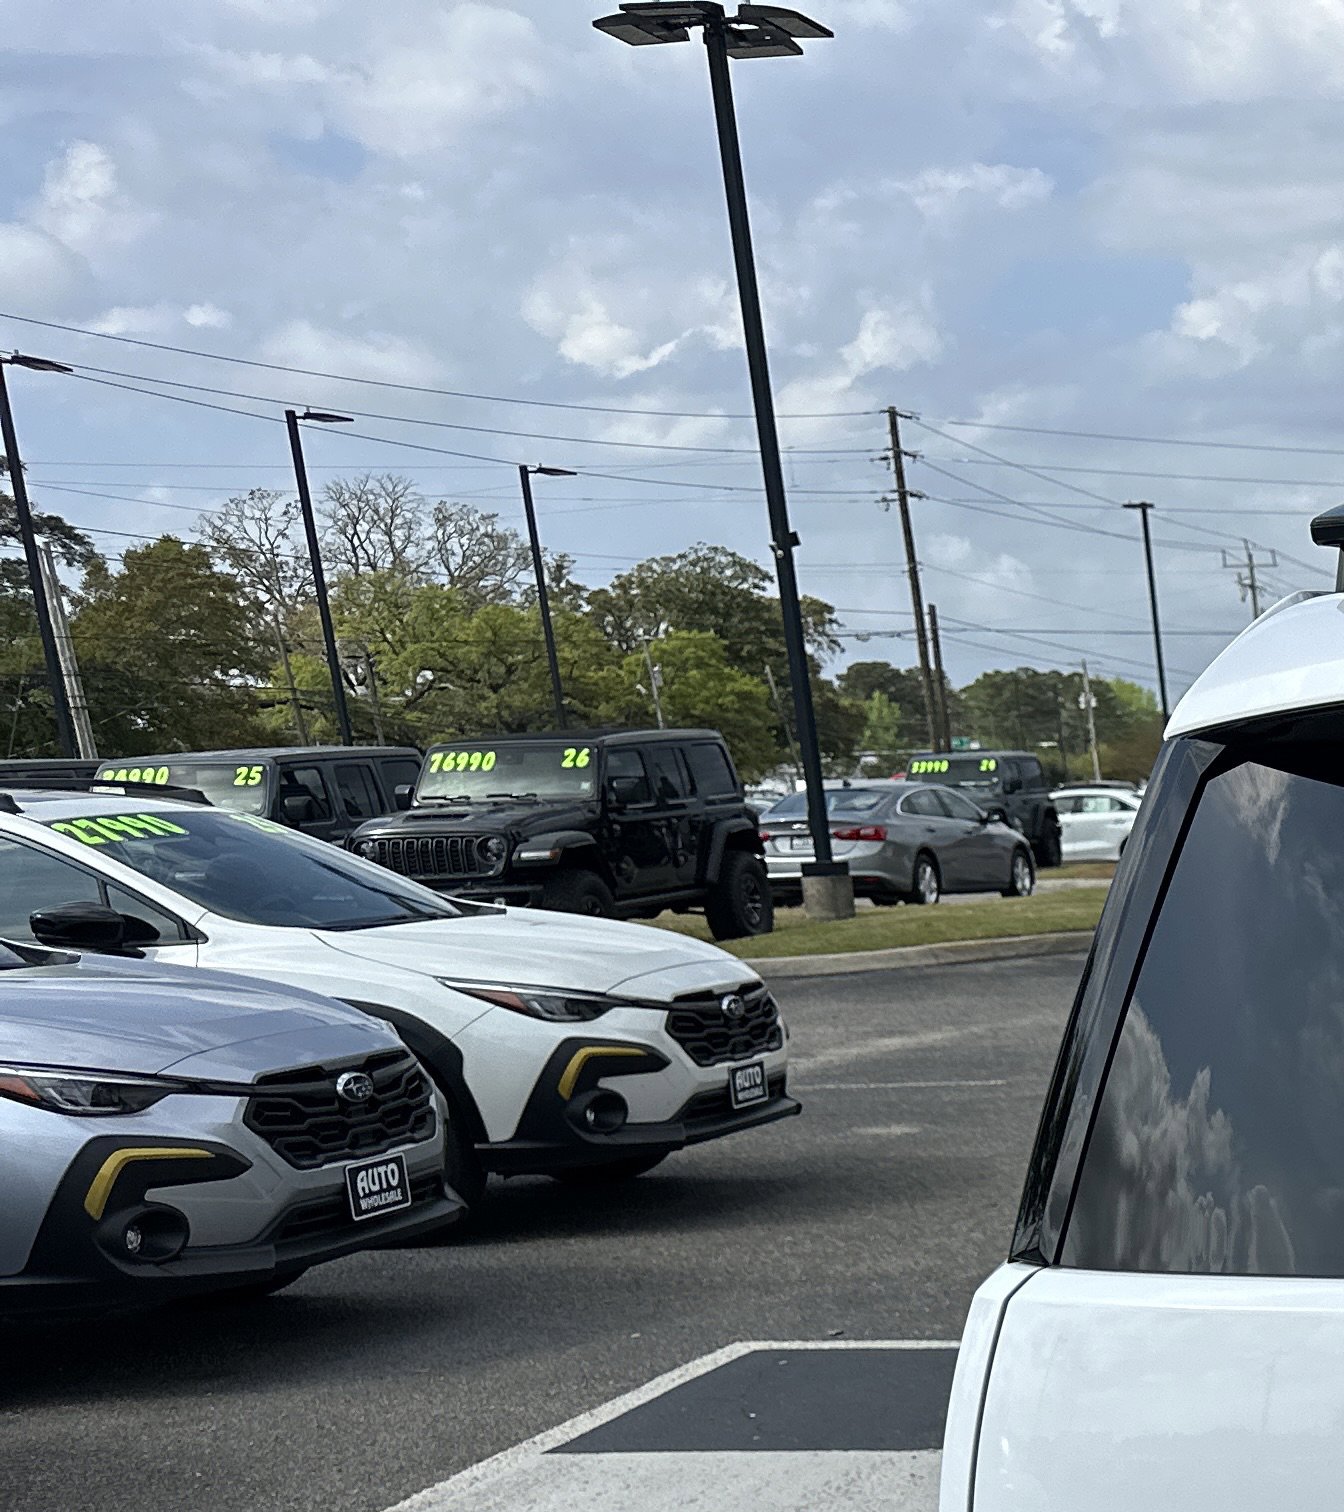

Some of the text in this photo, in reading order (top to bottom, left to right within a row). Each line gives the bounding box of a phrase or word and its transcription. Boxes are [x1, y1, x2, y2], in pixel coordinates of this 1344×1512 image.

[429, 751, 496, 773] 76990
[561, 748, 590, 768] 26
[233, 766, 263, 786] 25
[50, 813, 189, 845] 27990
[735, 1065, 762, 1091] AUTO
[356, 1162, 400, 1198] AUTO
